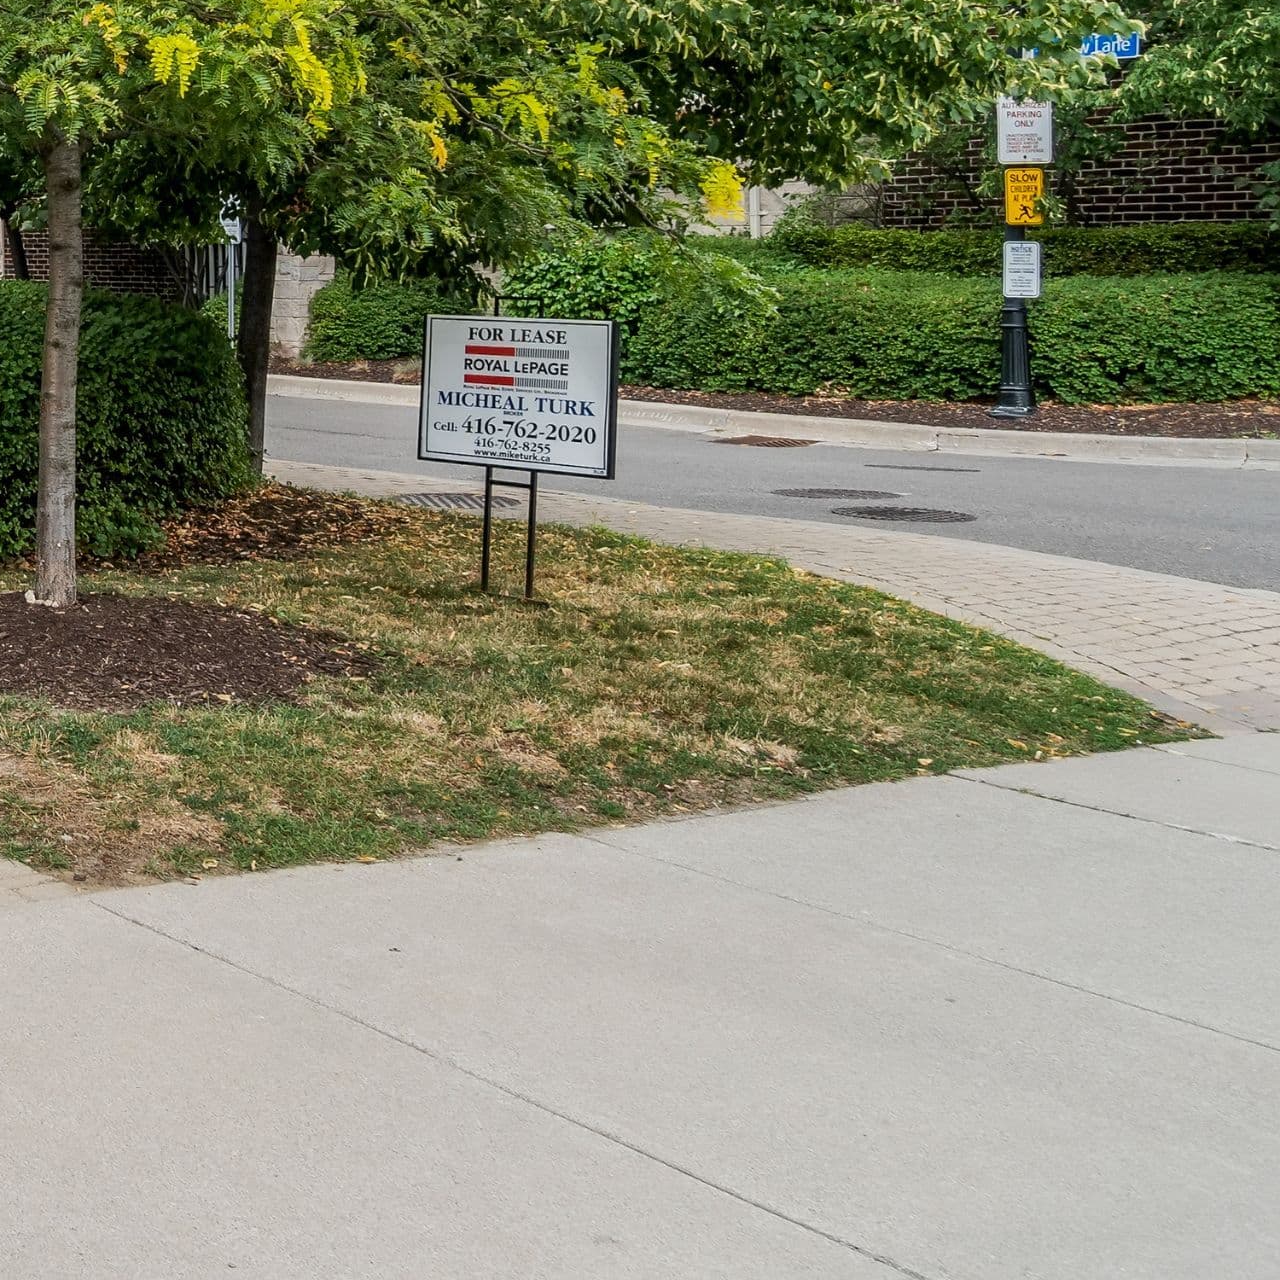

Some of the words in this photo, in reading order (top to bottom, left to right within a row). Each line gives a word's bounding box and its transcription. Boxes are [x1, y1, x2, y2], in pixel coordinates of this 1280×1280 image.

[1094, 36, 1130, 52] Lane
[1010, 174, 1038, 182] SLOW
[468, 327, 503, 341] FOR
[510, 328, 567, 344] LEASE
[464, 358, 510, 372] ROYAL
[437, 390, 528, 412] MICHEAL
[534, 397, 596, 417] TURK
[433, 421, 458, 432] Cell:
[461, 415, 597, 445] 416-762-2020
[474, 436, 551, 455] 416-762-8255
[474, 448, 551, 463] www.miketurk.ca
